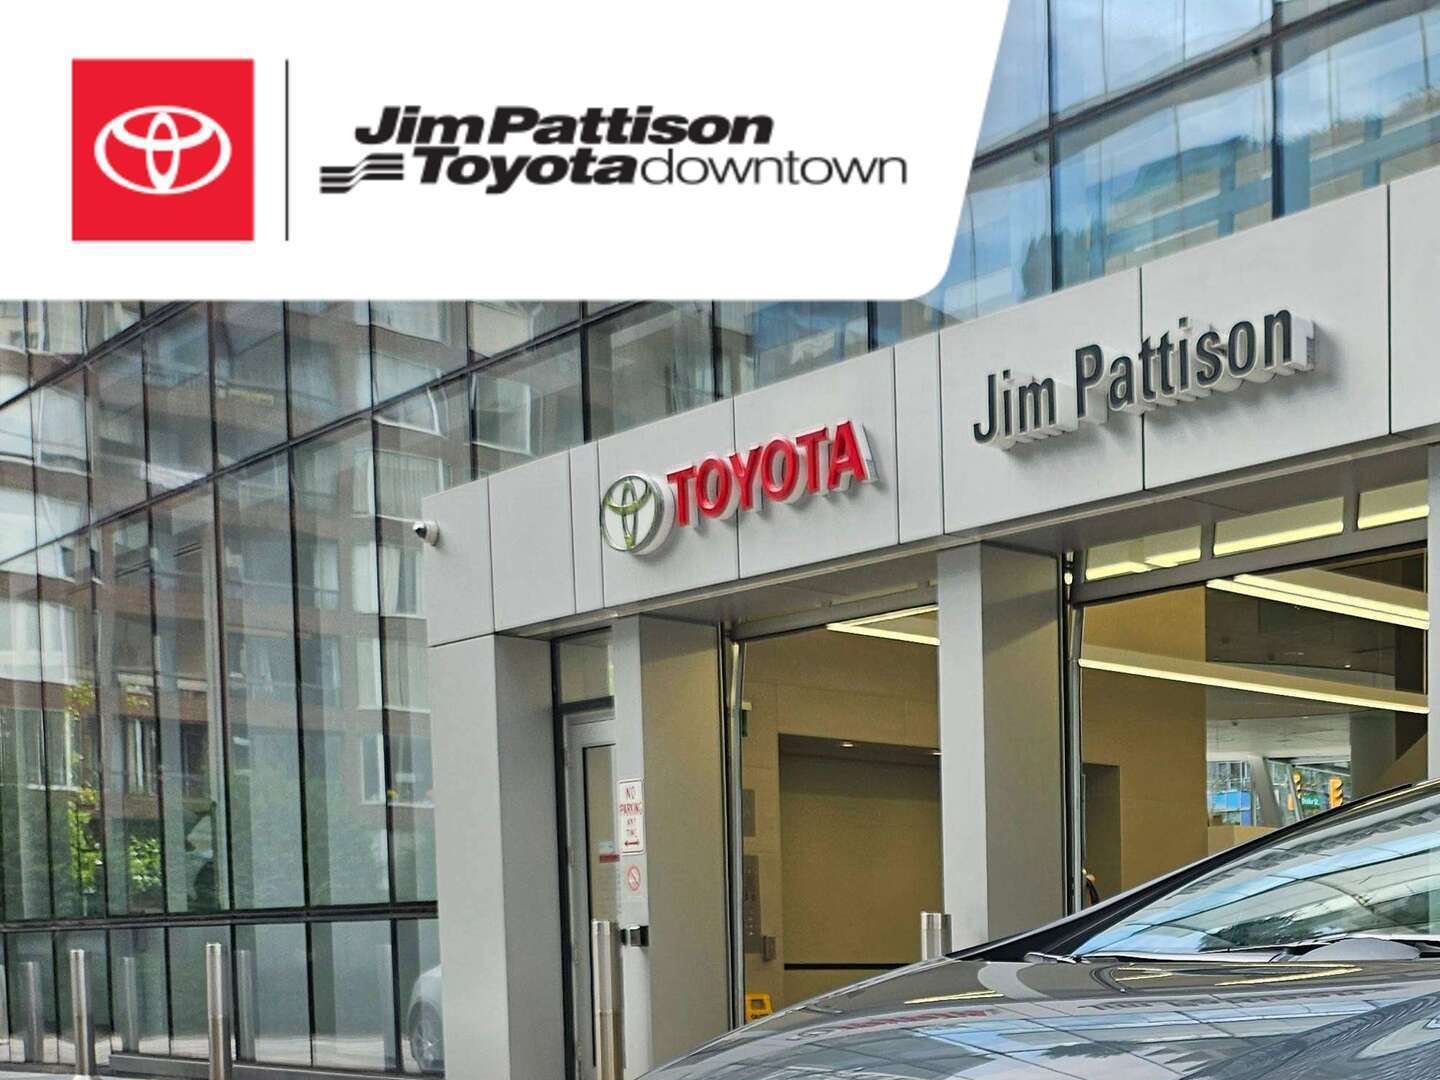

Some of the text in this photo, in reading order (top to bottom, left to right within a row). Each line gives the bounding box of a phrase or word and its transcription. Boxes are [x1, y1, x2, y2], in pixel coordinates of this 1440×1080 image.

[973, 308, 1294, 444] Jim Pattison
[666, 420, 868, 527] TOYOTA
[624, 786, 636, 800] NO
